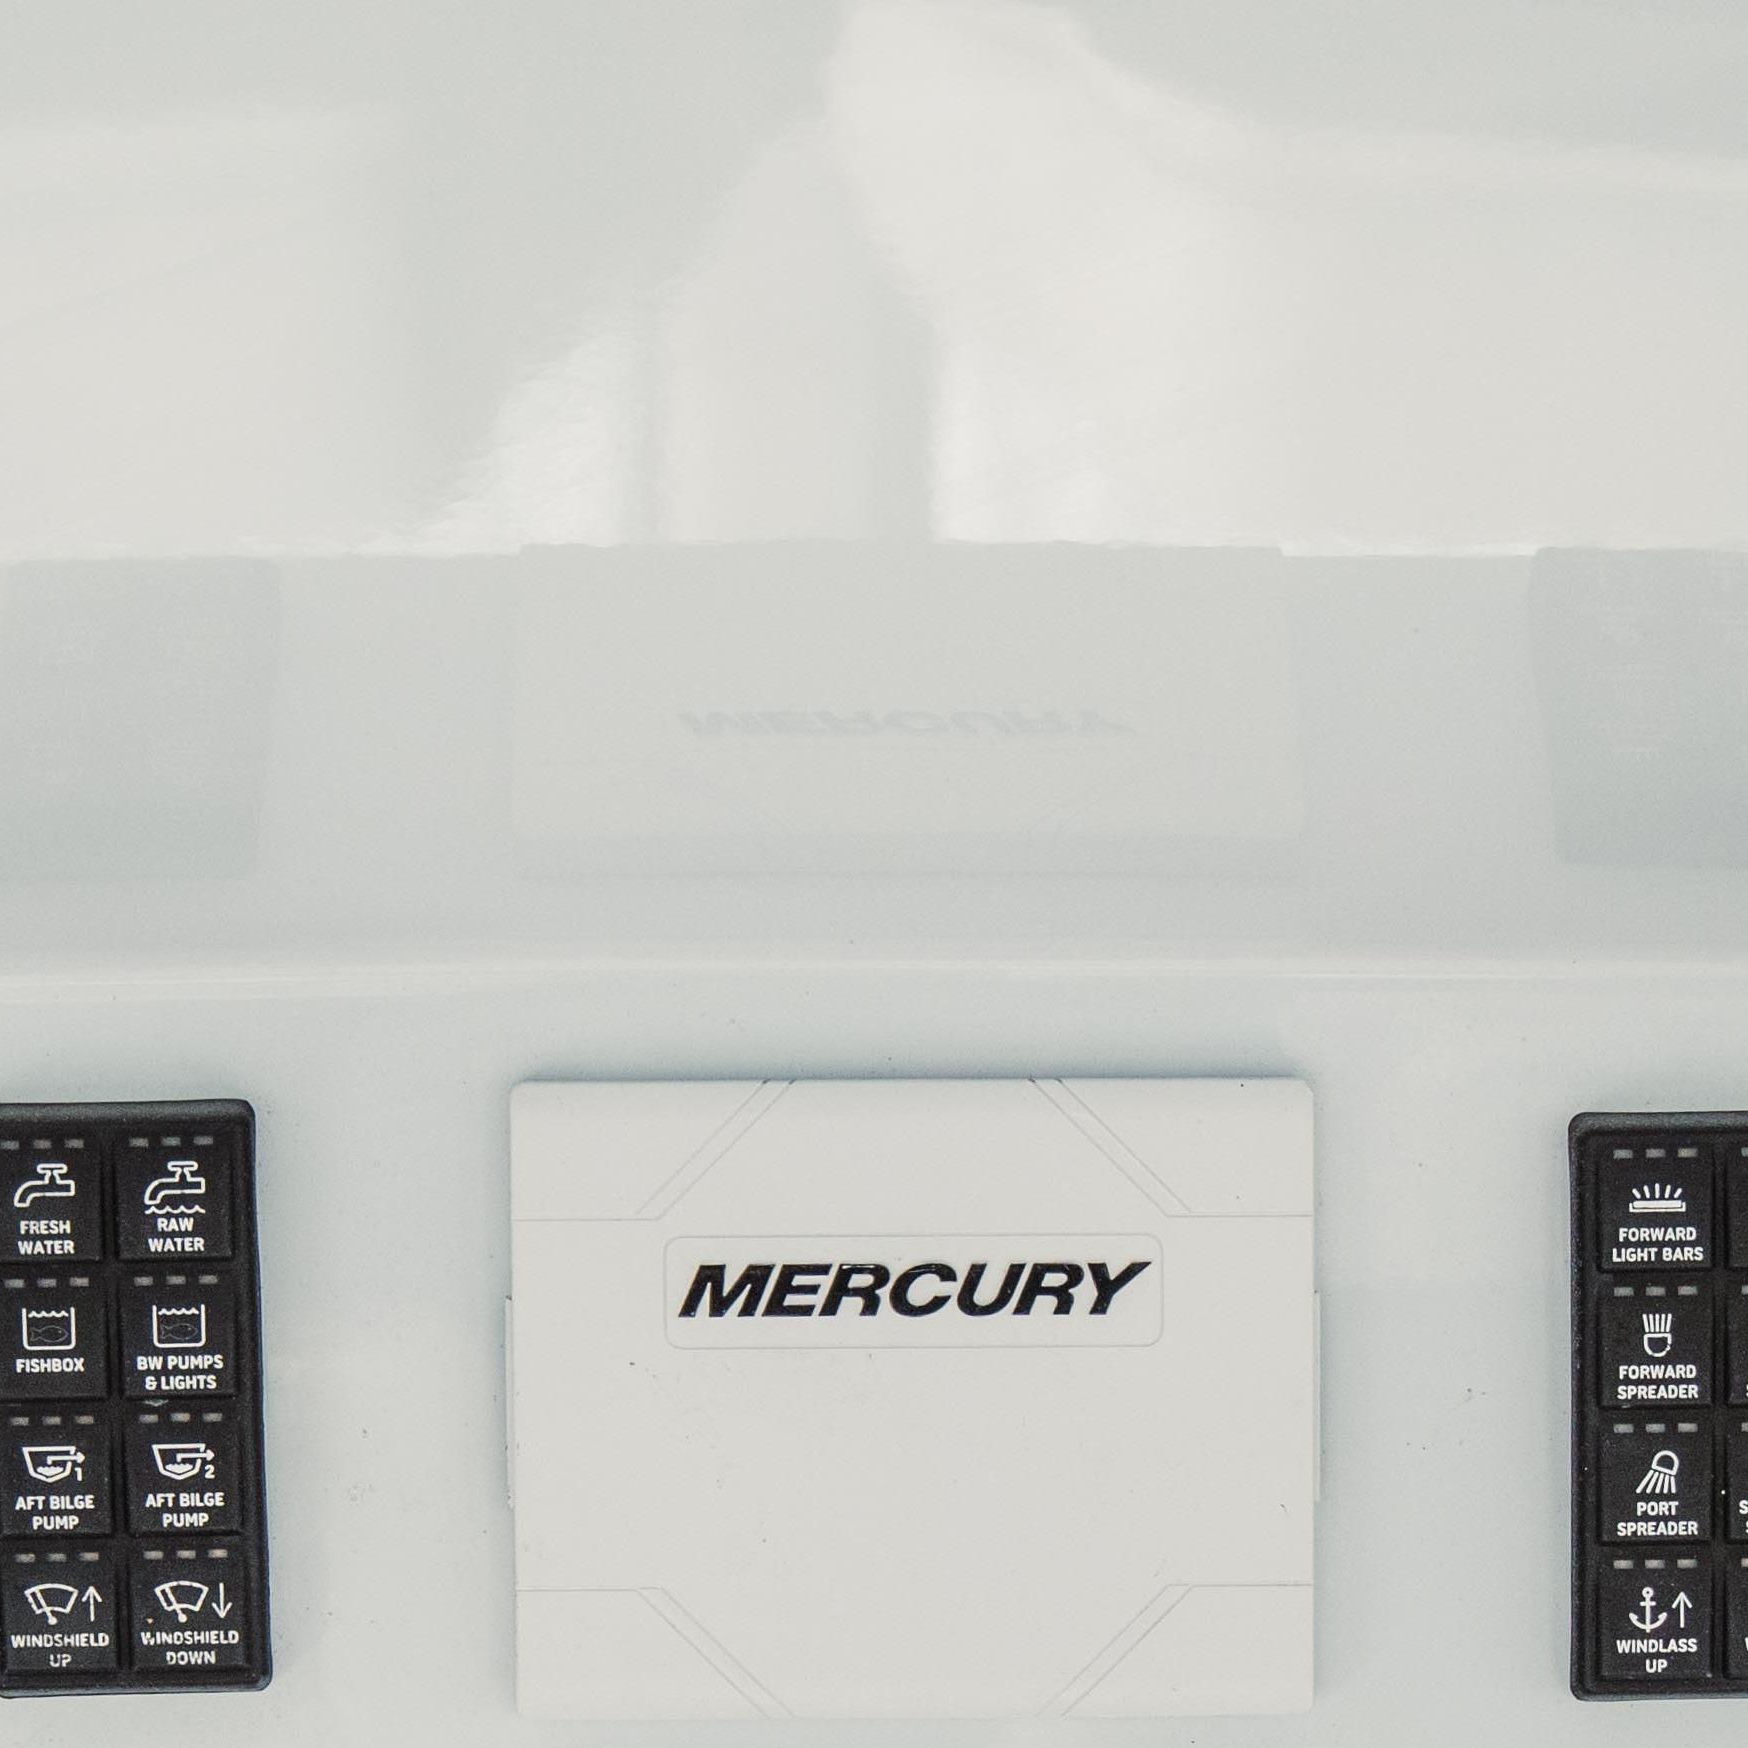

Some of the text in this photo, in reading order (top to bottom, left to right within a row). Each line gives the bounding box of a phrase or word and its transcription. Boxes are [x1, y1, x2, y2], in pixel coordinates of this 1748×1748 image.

[19, 1219, 71, 1235] FRESH
[156, 1216, 194, 1232] RAW
[1618, 1226, 1697, 1243] FORWARD
[17, 1239, 75, 1255] WATER
[147, 1236, 205, 1253] WATER
[1612, 1246, 1704, 1263] LIGHT BARS
[678, 1261, 1151, 1318] MERCURY
[15, 1357, 85, 1374] FISHBOX
[136, 1353, 224, 1371] BW PUMPS
[1618, 1363, 1697, 1380] FORWARD
[144, 1374, 217, 1391] & LIGHTS
[1616, 1383, 1699, 1400] SPREADER
[74, 1465, 84, 1483] 1
[204, 1464, 216, 1479] 2
[14, 1494, 96, 1511] AFT BILGE
[144, 1491, 225, 1508] AFT BILGE
[1636, 1500, 1680, 1517] PORT
[32, 1514, 80, 1531] PUMP
[162, 1512, 210, 1528] PUMP
[1616, 1520, 1699, 1537] SPREADER
[10, 1632, 110, 1649] WINDSHIELD
[140, 1629, 240, 1646] WINDSHIELD
[1616, 1637, 1698, 1654] WINDLASS
[49, 1653, 72, 1668] UP
[165, 1650, 216, 1666] DOWN
[1645, 1658, 1668, 1674] UP
